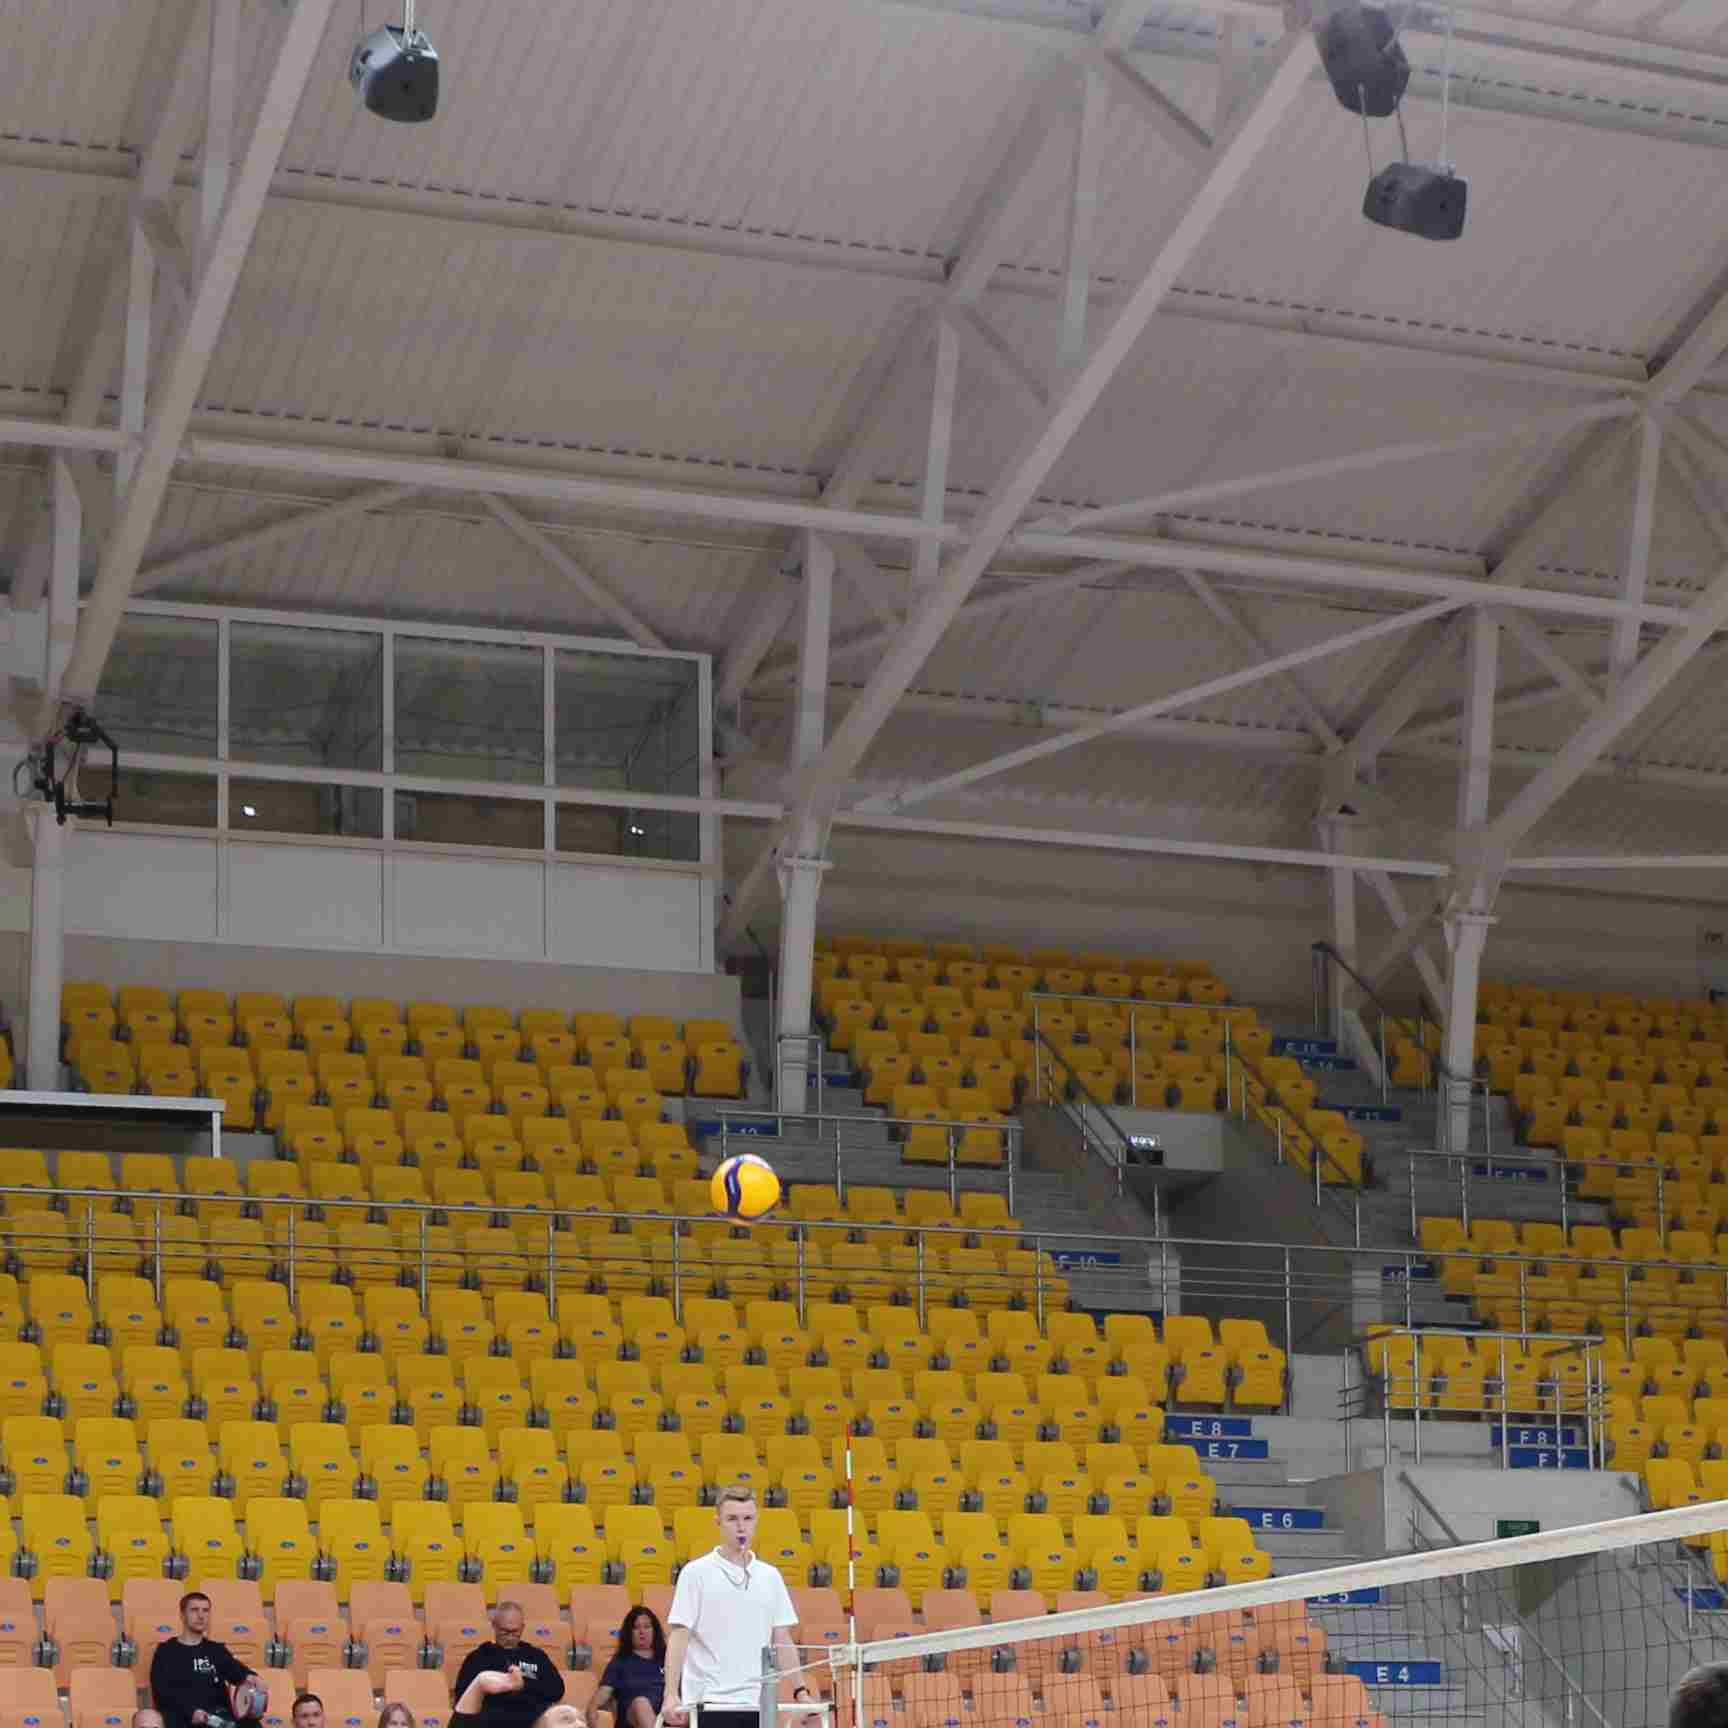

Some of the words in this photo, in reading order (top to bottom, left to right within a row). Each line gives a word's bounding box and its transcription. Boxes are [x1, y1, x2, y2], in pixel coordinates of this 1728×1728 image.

[1191, 1421, 1203, 1437] E
[1211, 1421, 1222, 1438] 8
[1537, 1430, 1549, 1446] 8
[1208, 1443, 1220, 1458] E
[1227, 1443, 1240, 1458] 7
[1261, 1512, 1273, 1529] E
[1282, 1512, 1294, 1529] 6
[1376, 1666, 1389, 1682] E
[1397, 1666, 1410, 1682] 4
